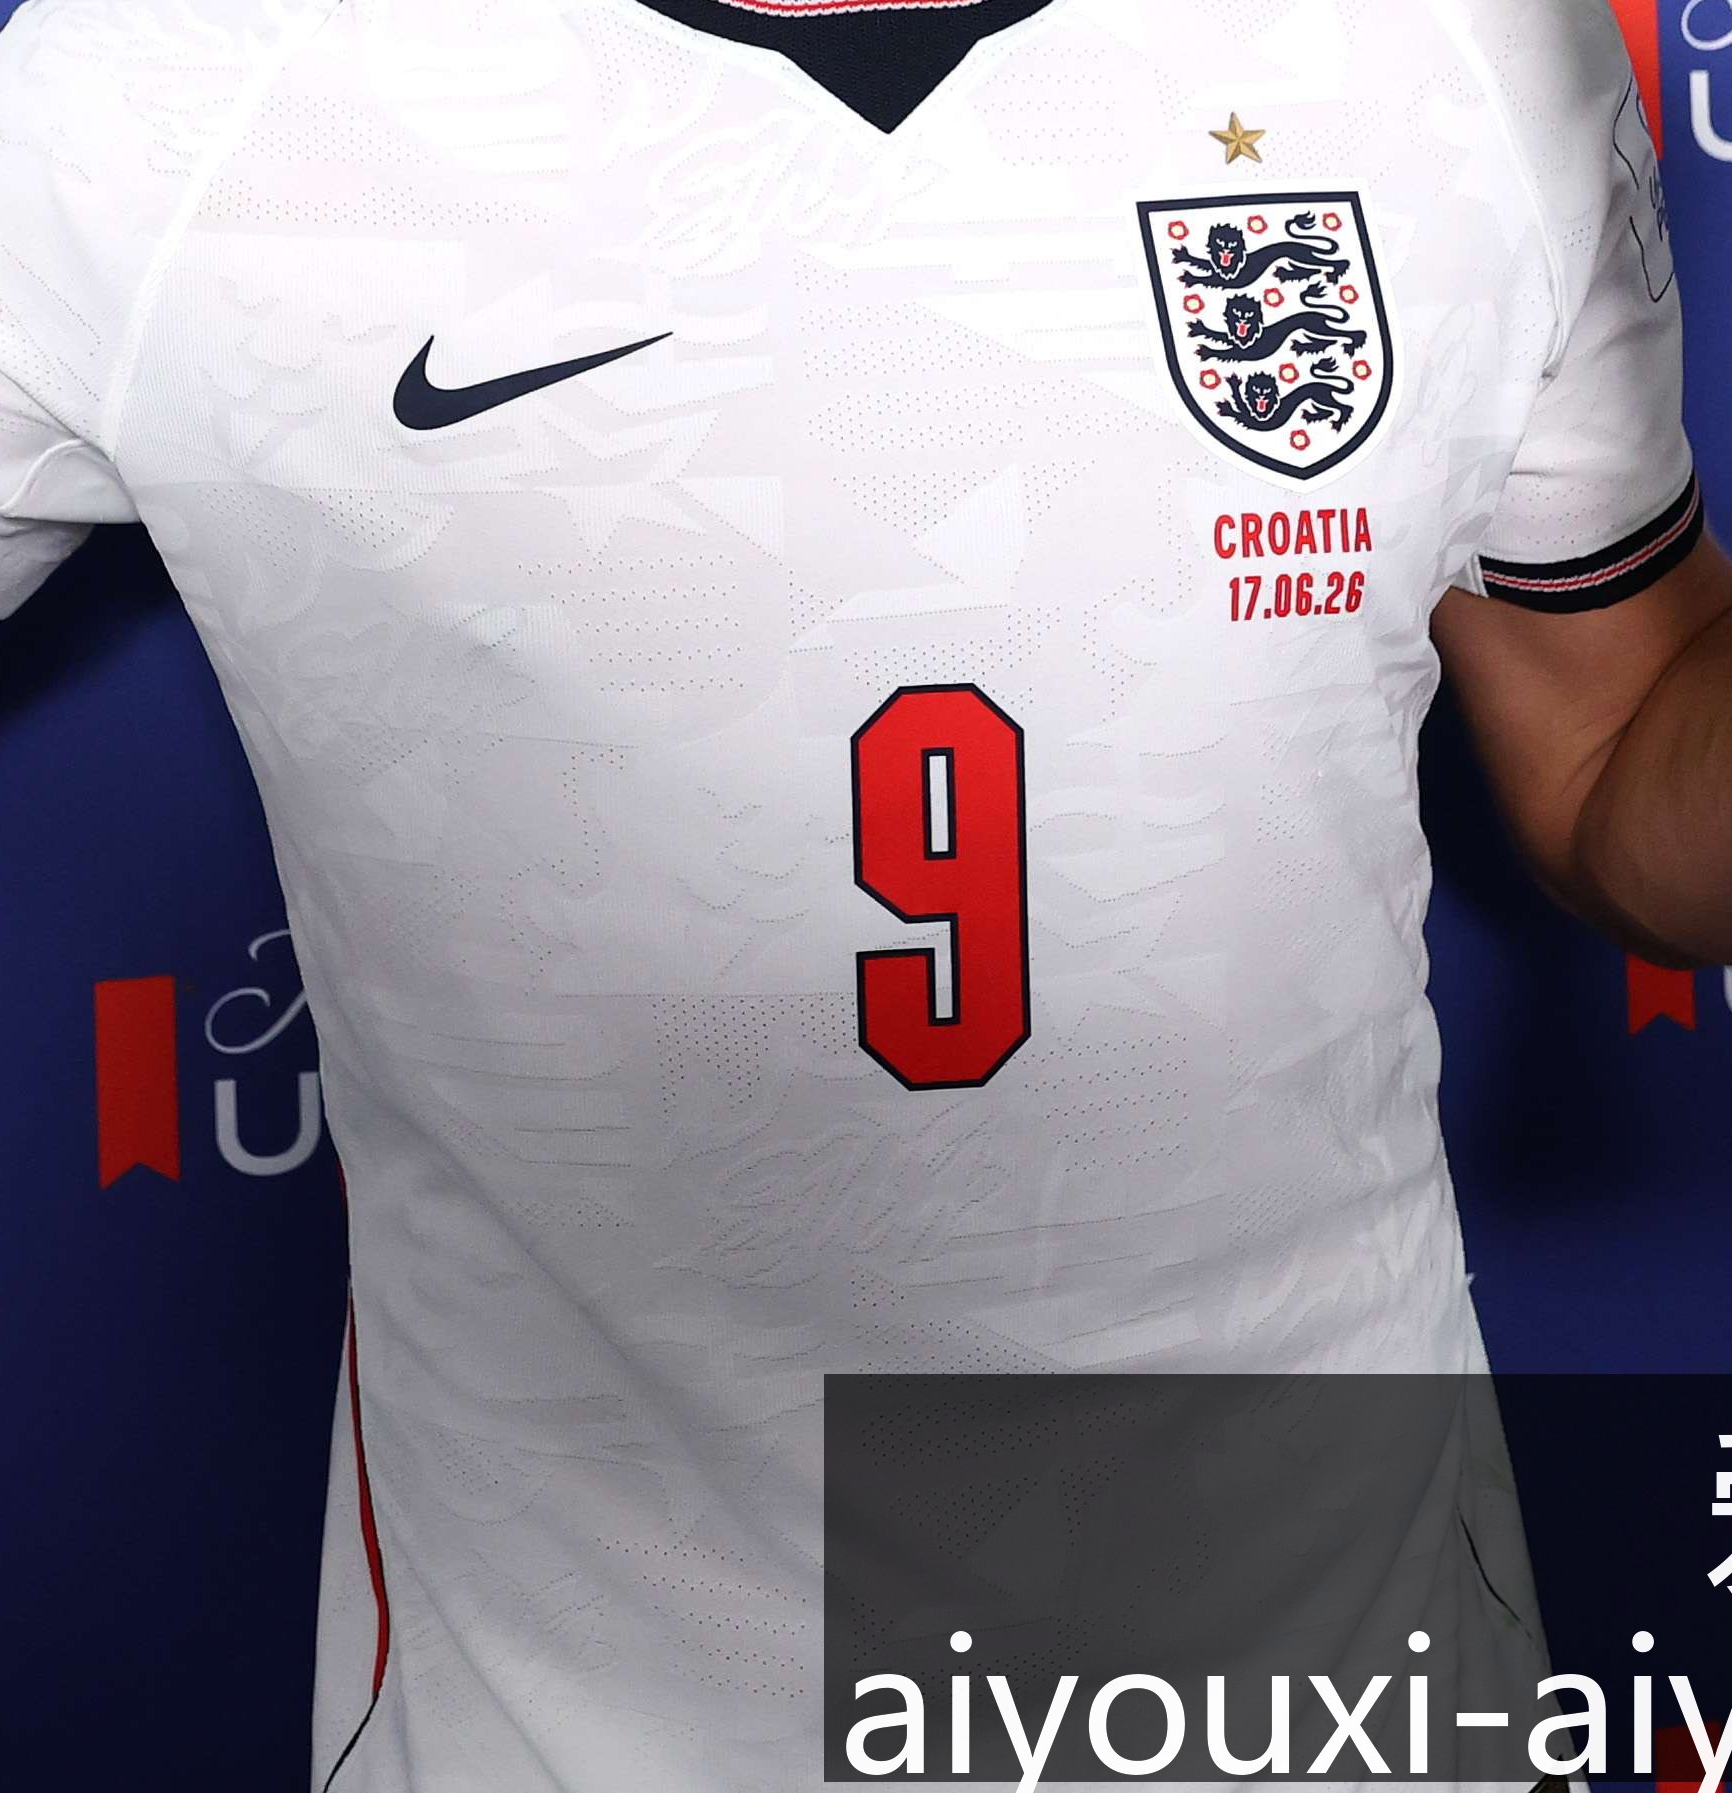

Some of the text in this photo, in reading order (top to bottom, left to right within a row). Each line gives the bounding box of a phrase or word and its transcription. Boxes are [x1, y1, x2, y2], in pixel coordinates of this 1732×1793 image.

[1213, 507, 1374, 560] CROATIA
[1228, 570, 1367, 623] 17.06.26
[851, 683, 1031, 1091] 9
